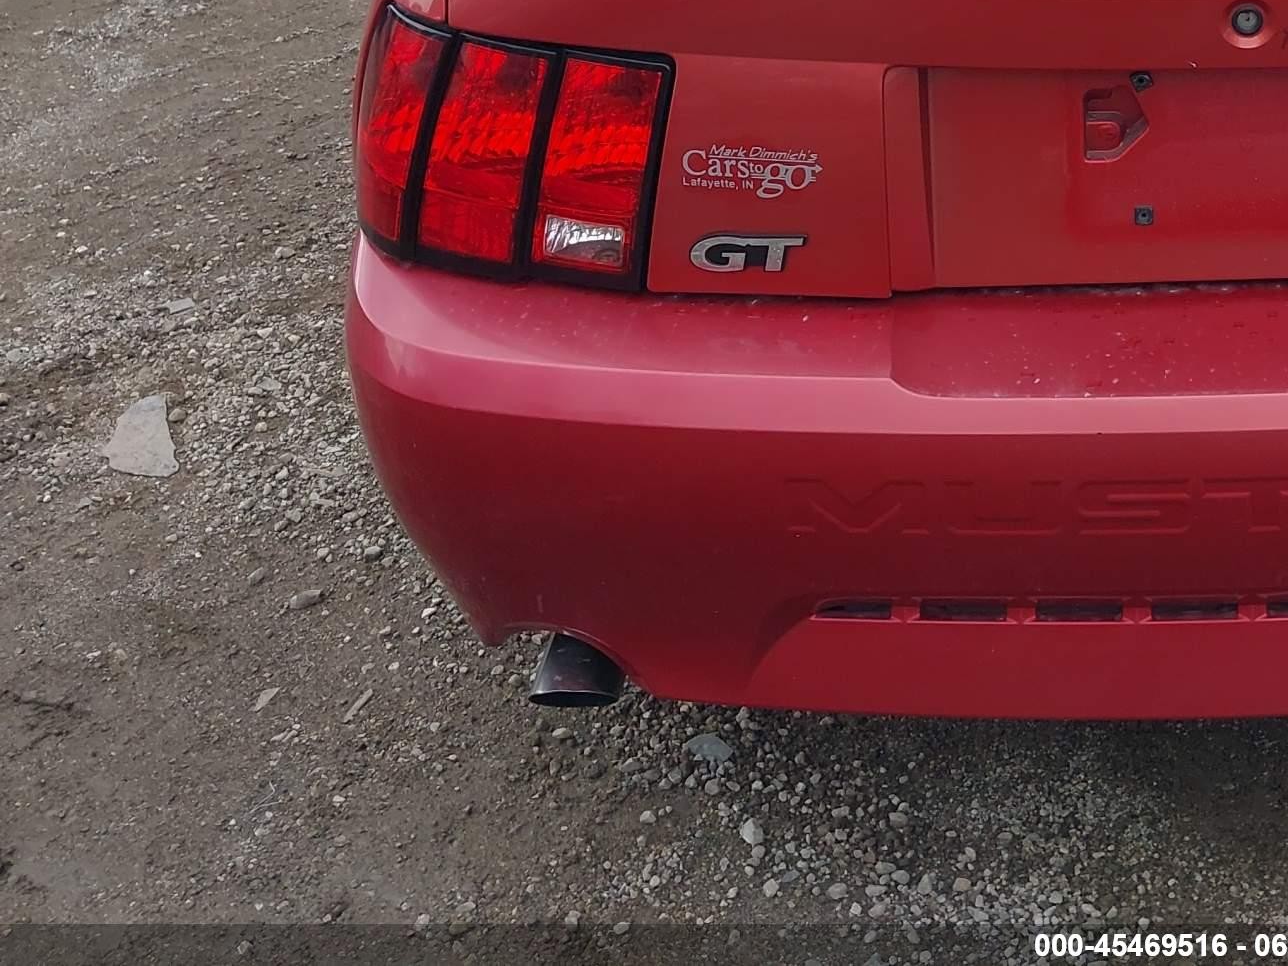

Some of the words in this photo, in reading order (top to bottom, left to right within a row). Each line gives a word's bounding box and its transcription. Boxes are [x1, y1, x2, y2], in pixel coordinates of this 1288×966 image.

[710, 144, 746, 158] Mark
[682, 149, 750, 178] Cars
[750, 163, 764, 174] to
[682, 177, 739, 190] Lafayette,
[742, 180, 755, 190] IN
[756, 163, 812, 199] go
[690, 236, 805, 273] GT
